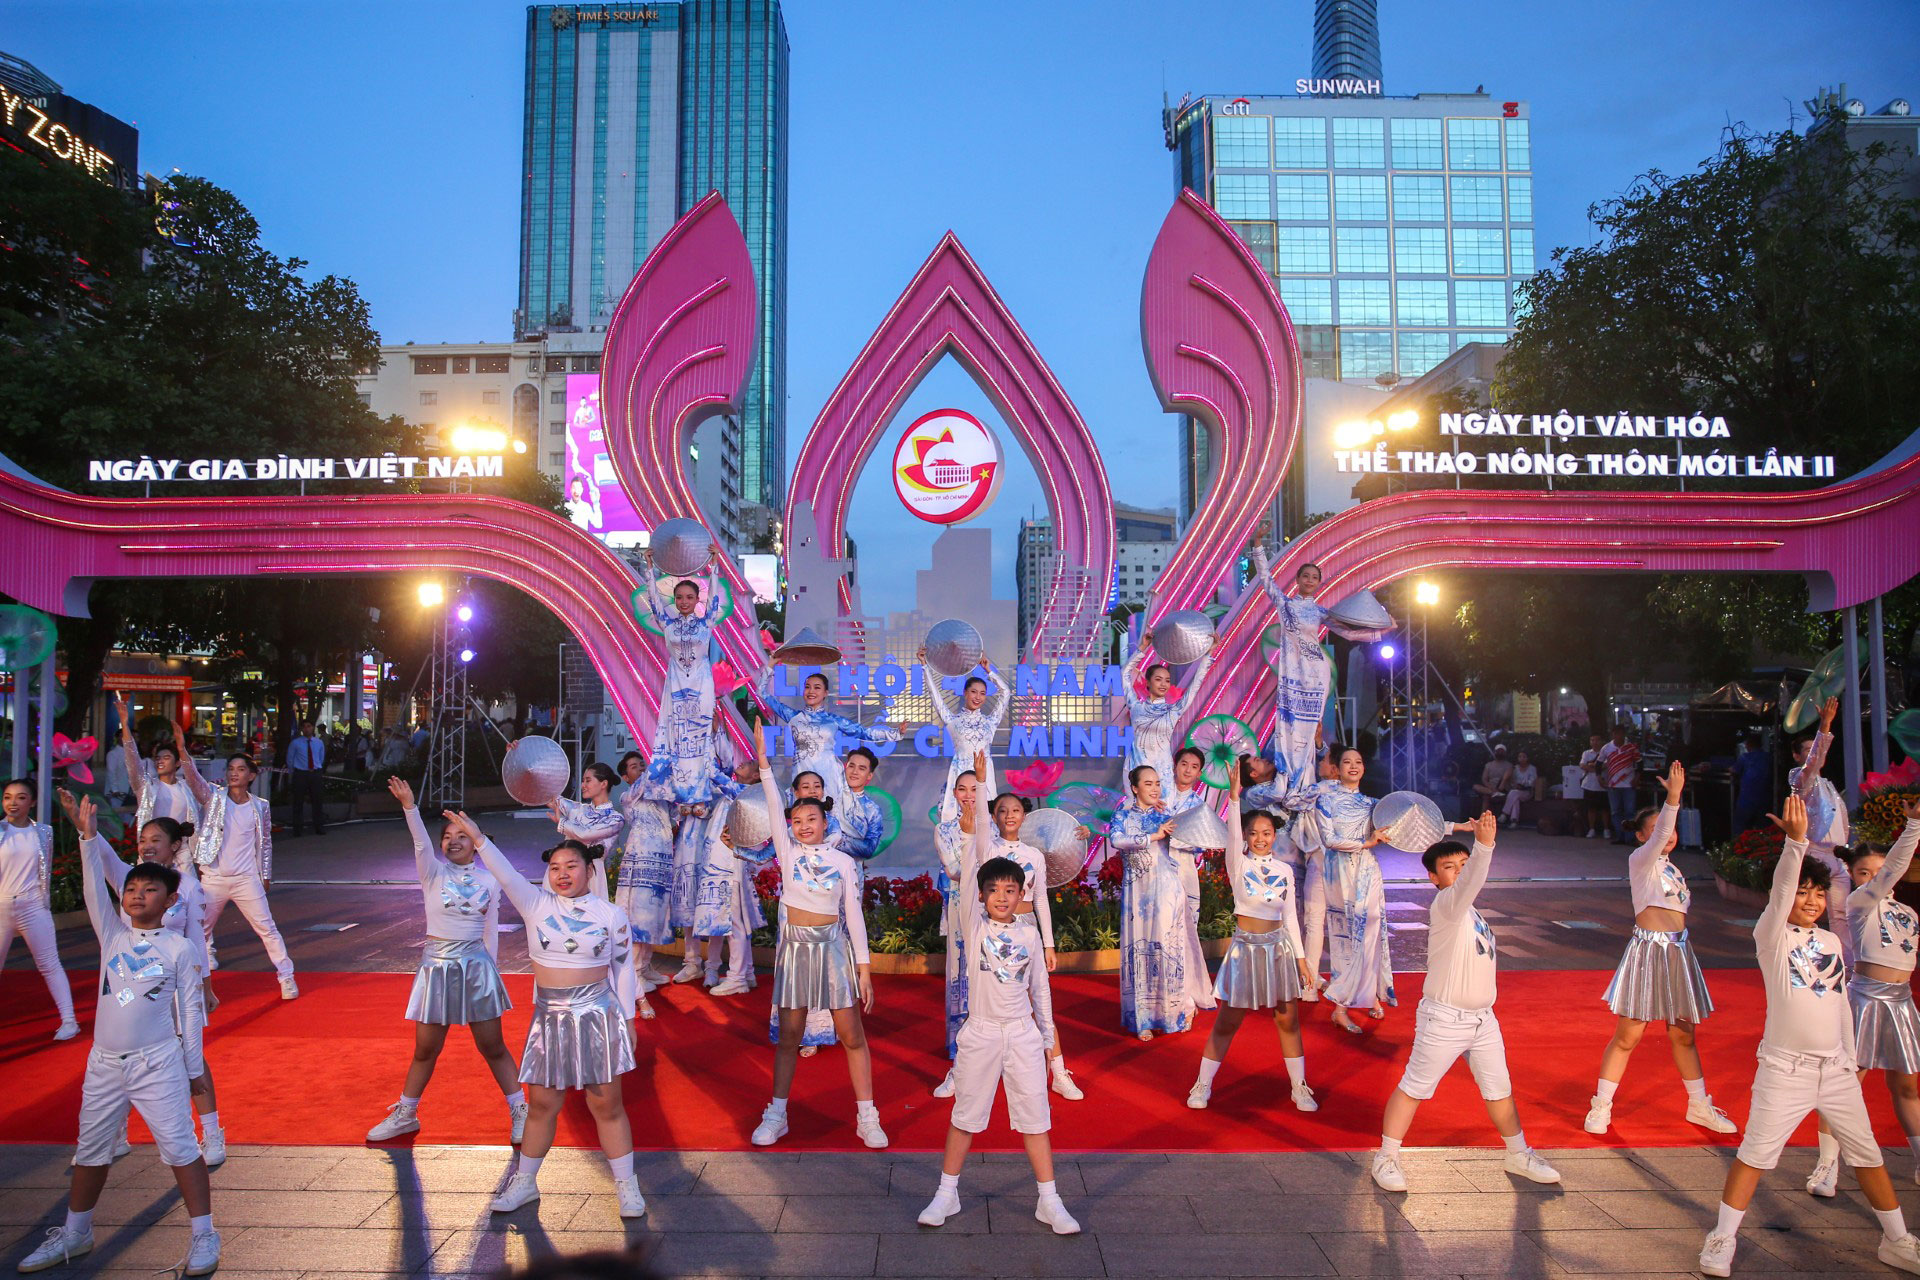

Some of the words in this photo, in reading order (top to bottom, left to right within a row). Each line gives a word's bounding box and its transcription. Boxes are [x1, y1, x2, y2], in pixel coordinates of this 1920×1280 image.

[576, 11, 610, 21] TIMES
[613, 10, 659, 20] SQUARE
[1296, 79, 1380, 94] SUNWAH
[1222, 99, 1250, 115] citi
[1440, 408, 1523, 435] NGÀY
[1531, 409, 1586, 442] HỘI
[1594, 410, 1656, 437] VĂN
[1665, 410, 1731, 437] HÓA
[89, 455, 180, 481] NGÀY
[188, 459, 247, 481] GIA
[256, 454, 335, 480] ĐÌNH
[344, 452, 419, 484] VIỆT
[428, 456, 503, 478] NAM
[1333, 441, 1388, 473] THỂ
[1397, 451, 1478, 474] THAO
[1487, 446, 1579, 475] NÔNG
[1585, 448, 1670, 476] THÔN
[1678, 449, 1737, 477] MỚI
[1745, 446, 1804, 477] LẦN
[1811, 456, 1834, 477] II
[838, 653, 924, 707] HỘI
[1015, 656, 1125, 697] NĂM
[1008, 726, 1134, 758] MINH
